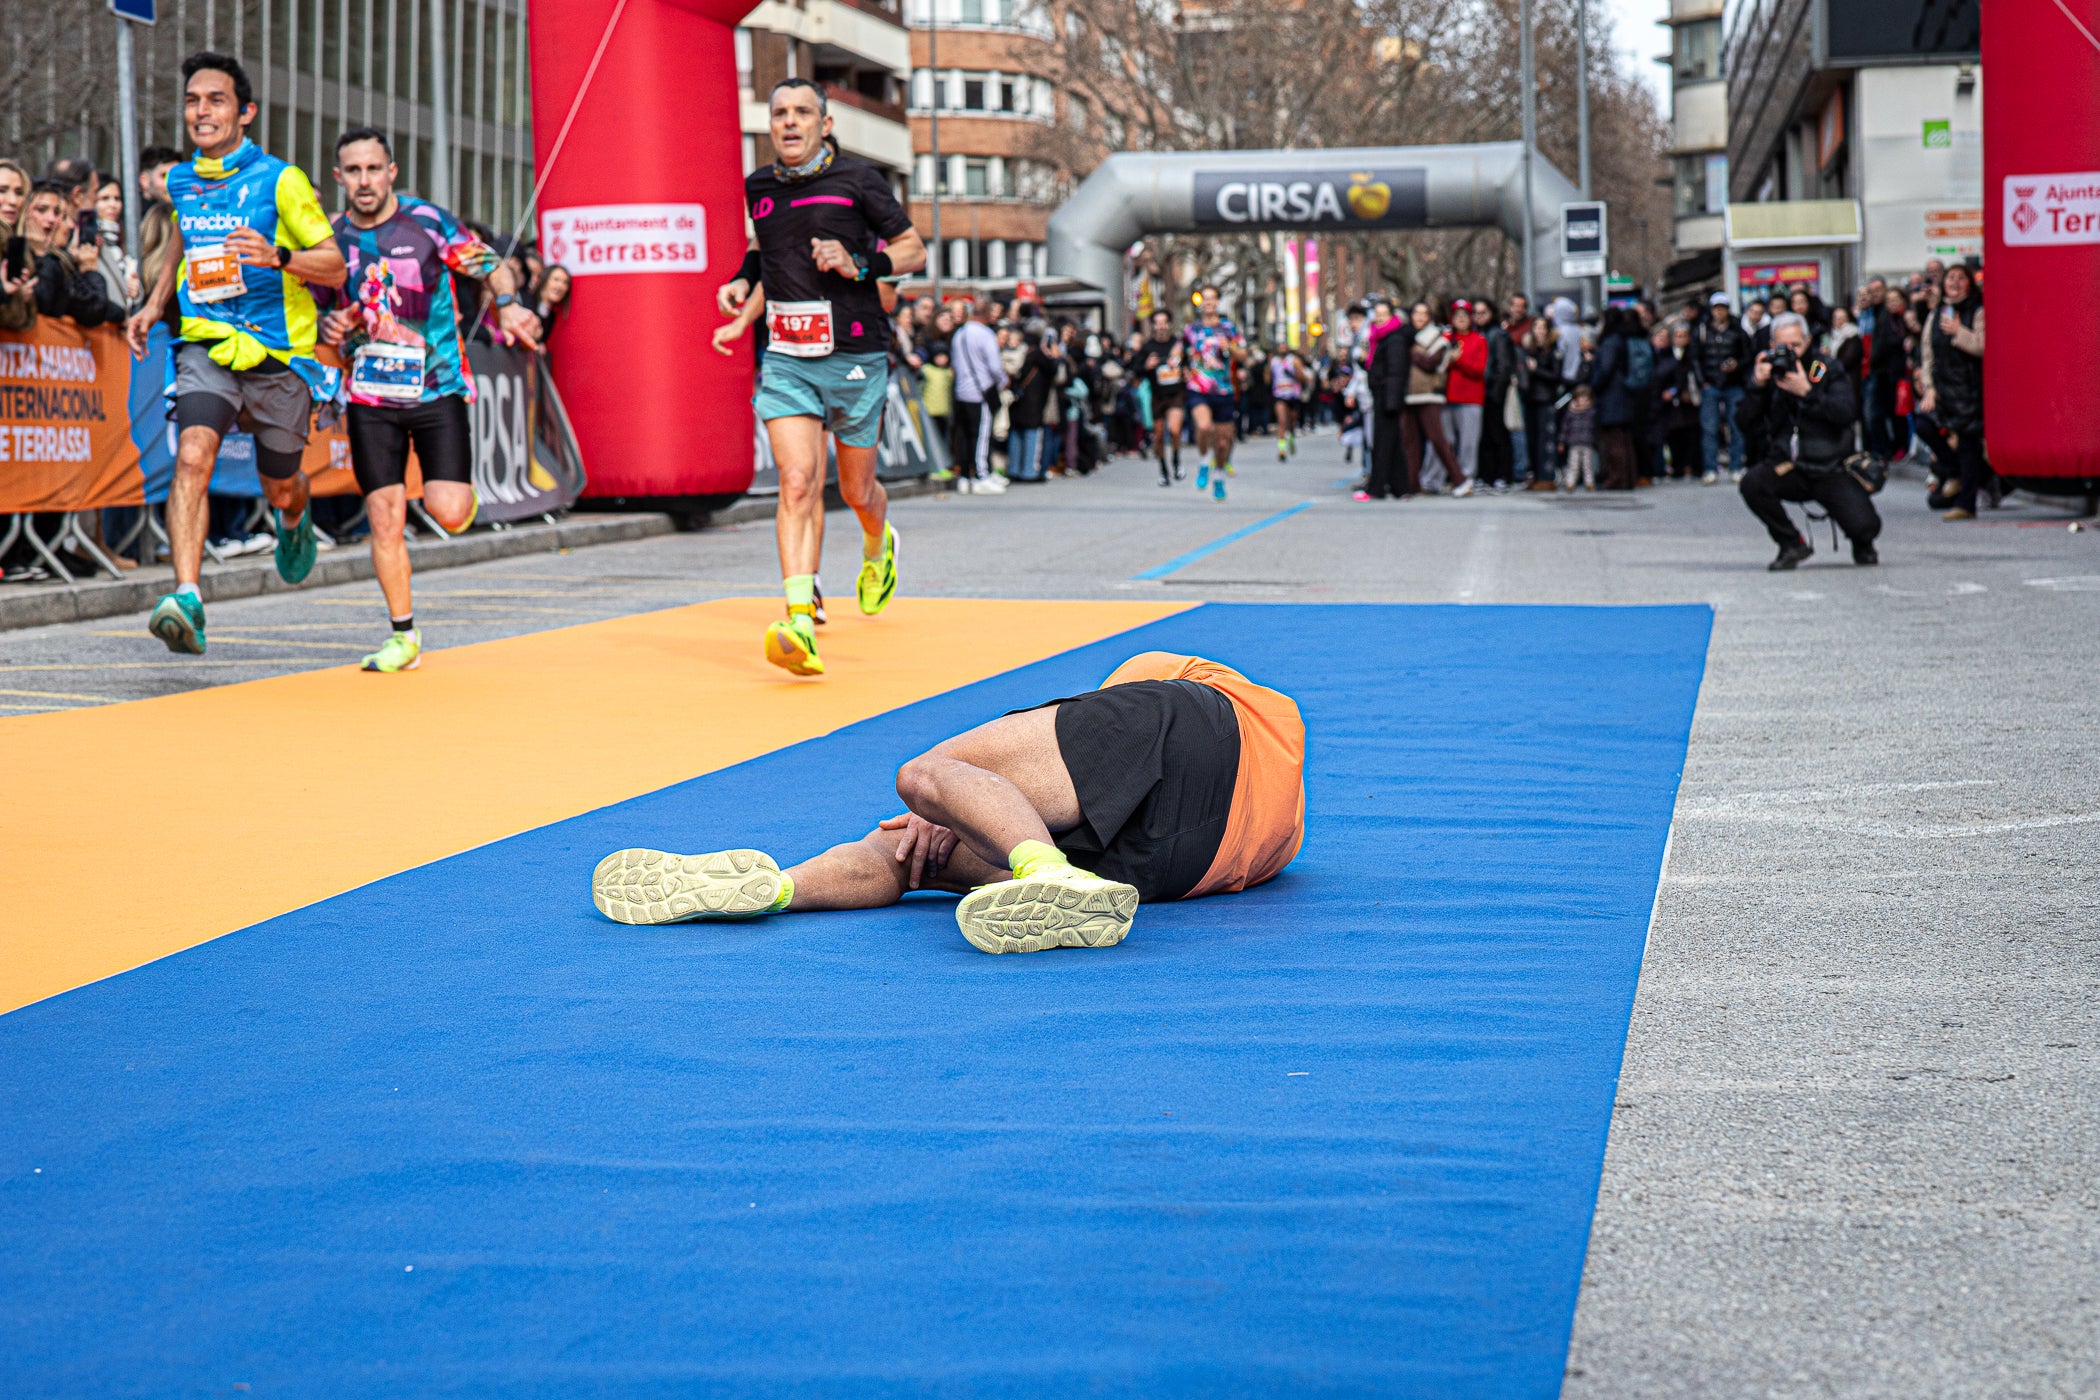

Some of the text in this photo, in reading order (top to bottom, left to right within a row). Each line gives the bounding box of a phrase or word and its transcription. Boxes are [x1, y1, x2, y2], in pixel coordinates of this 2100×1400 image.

[1216, 181, 1345, 223] CIRSA
[2045, 184, 2100, 204] Ajunta
[573, 216, 694, 233] Ajuntament de
[2045, 207, 2100, 234] Ter
[574, 239, 697, 263] Terrassa
[782, 316, 813, 331] 197
[0, 342, 39, 379] ITJA
[372, 358, 406, 372] 424
[0, 385, 106, 422] TERNACIONAL
[0, 425, 92, 463] E TERRASSA
